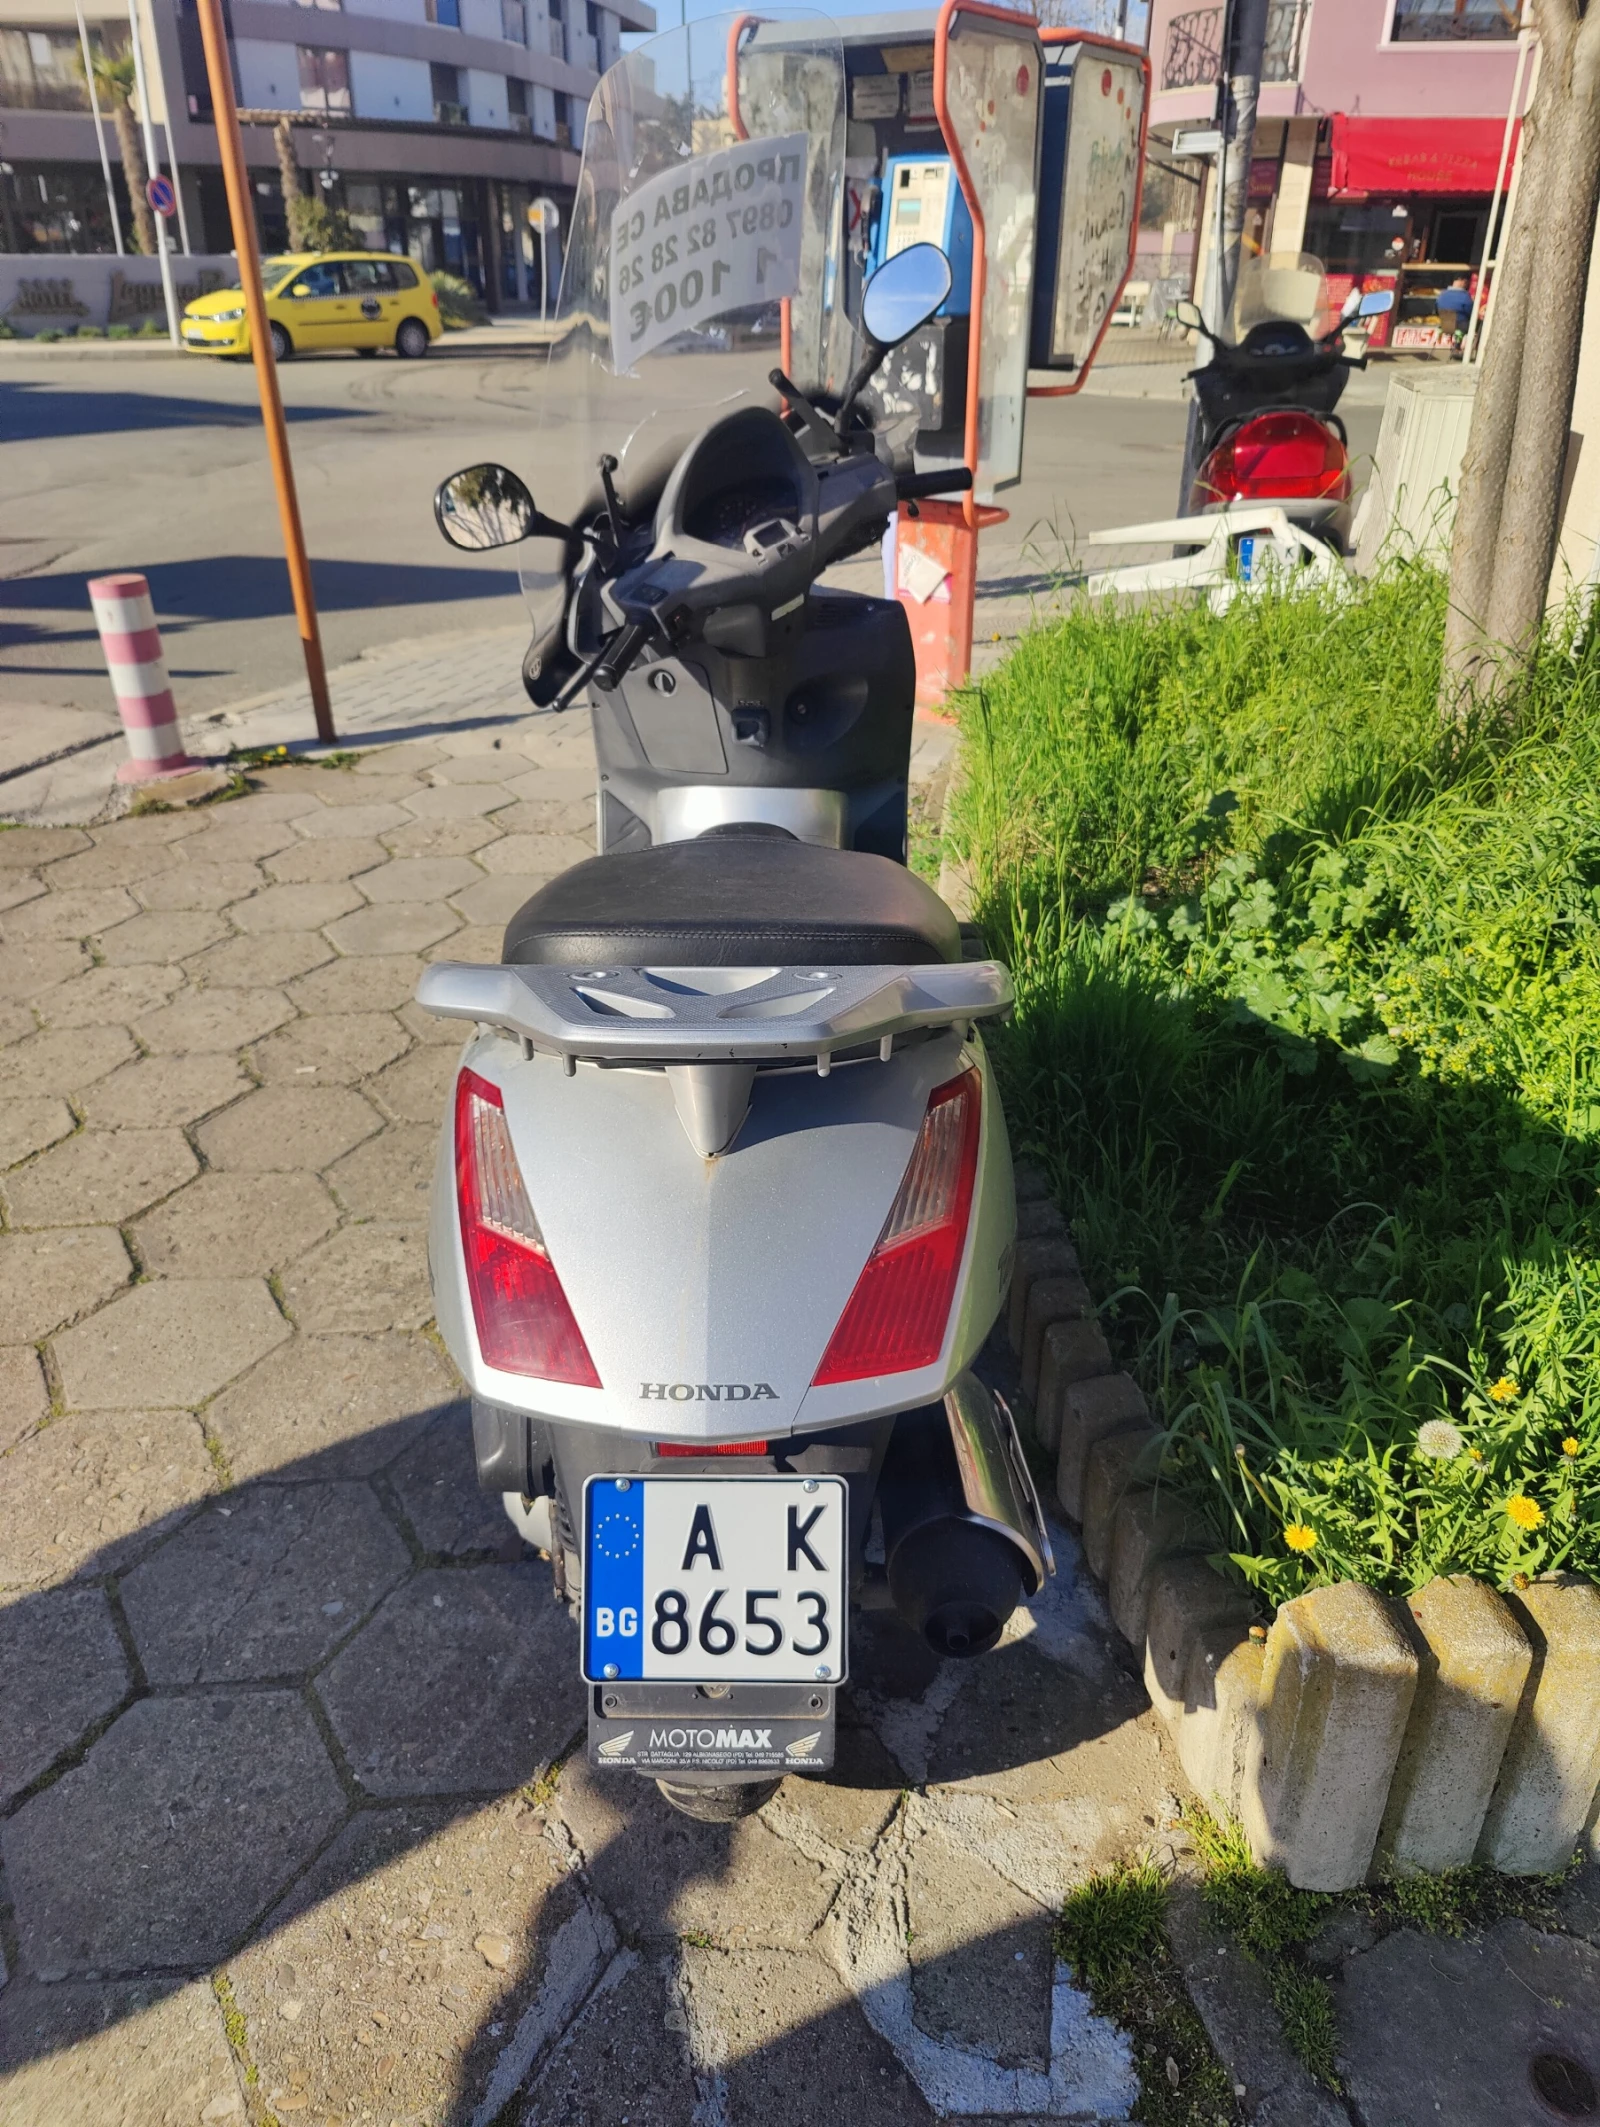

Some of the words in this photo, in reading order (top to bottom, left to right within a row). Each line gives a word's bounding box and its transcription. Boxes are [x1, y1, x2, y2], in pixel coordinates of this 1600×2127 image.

[639, 1382, 780, 1401] HONDA
[680, 1502, 724, 1571] A
[786, 1502, 829, 1572] K
[596, 1606, 638, 1638] BG
[651, 1587, 830, 1656] 8653
[648, 1728, 773, 1749] MOTOMAX
[785, 1757, 824, 1765] HONDA
